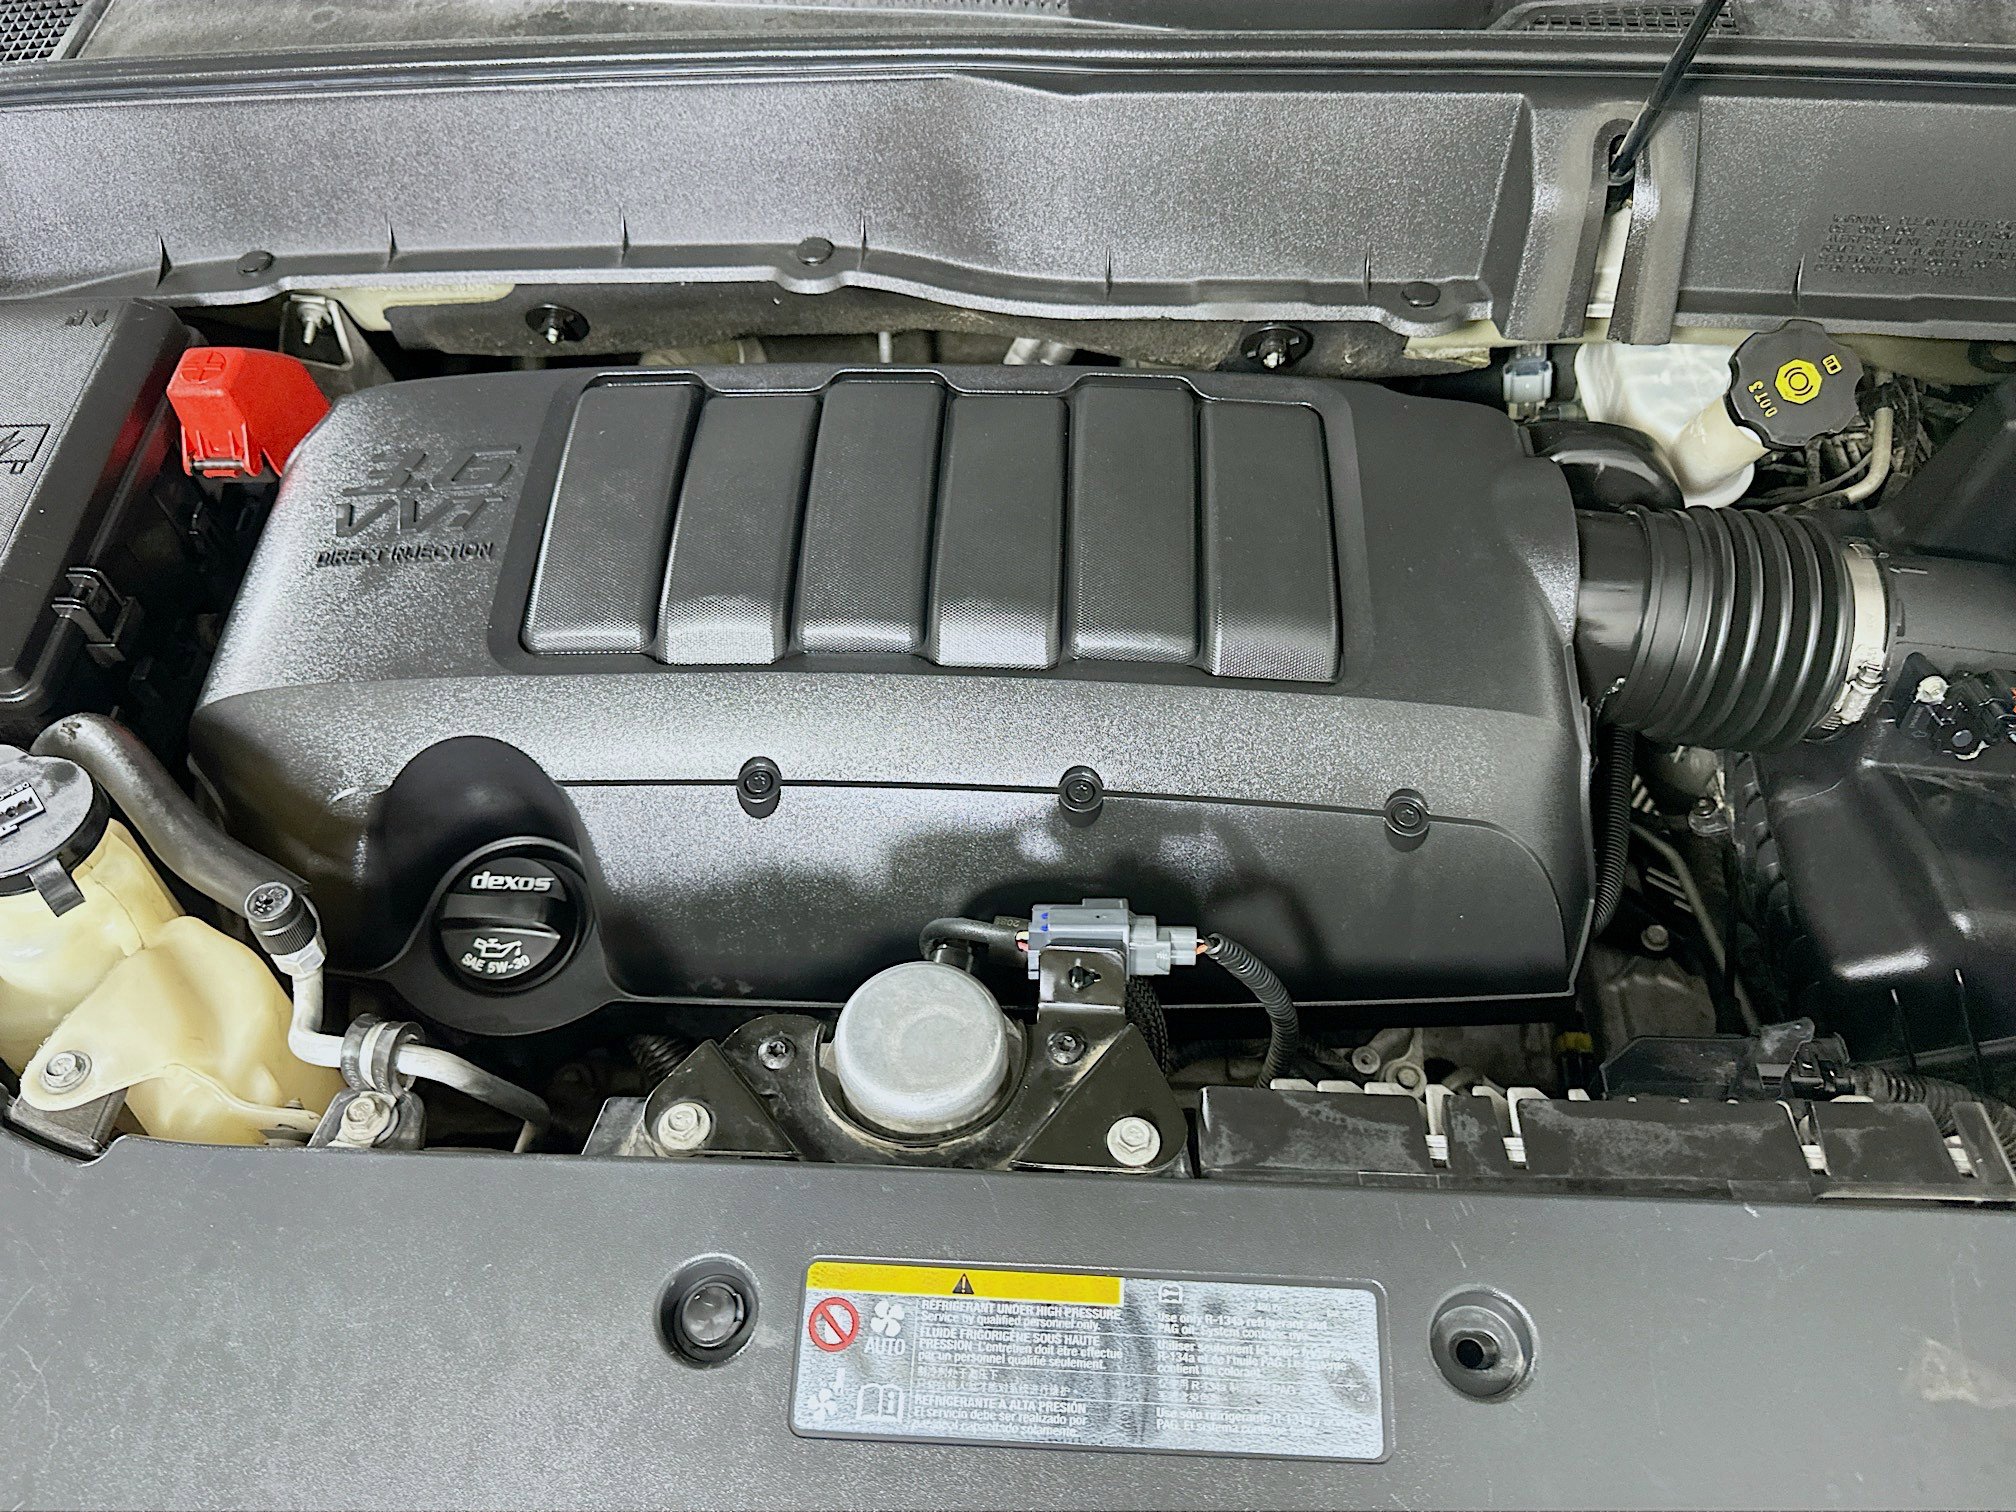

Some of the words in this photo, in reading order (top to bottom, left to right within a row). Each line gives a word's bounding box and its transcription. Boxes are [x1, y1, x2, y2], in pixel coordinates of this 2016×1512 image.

[336, 496, 509, 536] VVT
[315, 547, 384, 568] DIRECT
[390, 542, 494, 563] INJECTION
[471, 871, 554, 891] dexos
[462, 953, 486, 972] SAE
[487, 954, 530, 974] 5W-30
[921, 1298, 996, 1313] REFRIGERANT
[997, 1302, 1036, 1315] UNDER
[1037, 1305, 1061, 1317] HIGH
[1064, 1306, 1121, 1320] PRESSURE
[1158, 1312, 1178, 1322] Use
[920, 1310, 960, 1323] Service
[962, 1313, 974, 1324] by
[976, 1313, 1020, 1327] qualified
[1023, 1316, 1074, 1330] personnel
[1076, 1319, 1100, 1331] only.
[1158, 1324, 1178, 1334] PAG
[864, 1336, 906, 1356] AUTO
[920, 1325, 957, 1338] FLUIDE
[1033, 1332, 1061, 1344] SOUS
[1064, 1333, 1100, 1346] HAUTE
[954, 1350, 1005, 1366] personnel
[1034, 1344, 1054, 1355] doit
[915, 1393, 994, 1409] REFRIGERANTE
[1009, 1398, 1036, 1410] ALTA
[1038, 1398, 1086, 1414] PRESIÓN
[927, 1406, 968, 1419] servicio
[970, 1408, 997, 1420] debe
[999, 1411, 1016, 1421] ser
[1018, 1411, 1066, 1424] realizado
[1068, 1415, 1088, 1427] por
